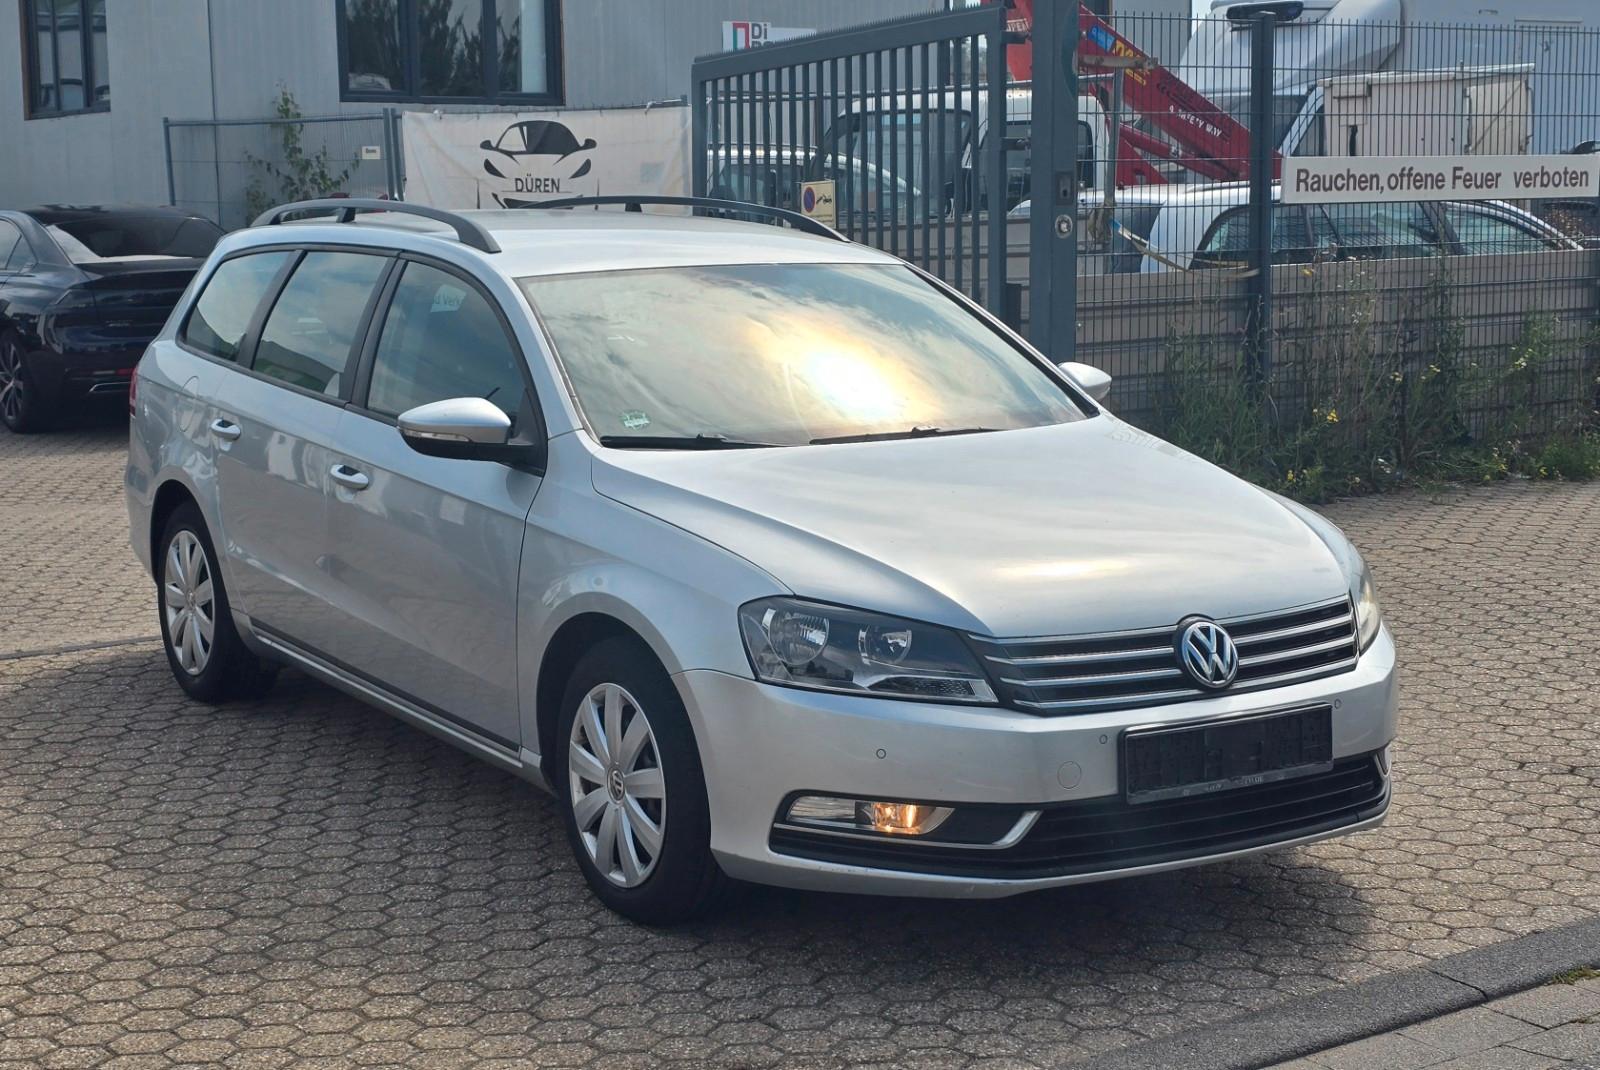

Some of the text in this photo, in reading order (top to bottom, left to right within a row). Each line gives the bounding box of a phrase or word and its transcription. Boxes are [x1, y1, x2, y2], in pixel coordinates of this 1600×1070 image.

[751, 22, 768, 40] Di
[514, 172, 561, 194] DÜREN
[1296, 165, 1589, 194] Rauchen, offene Feuer verboten
[1184, 624, 1235, 684] VW
